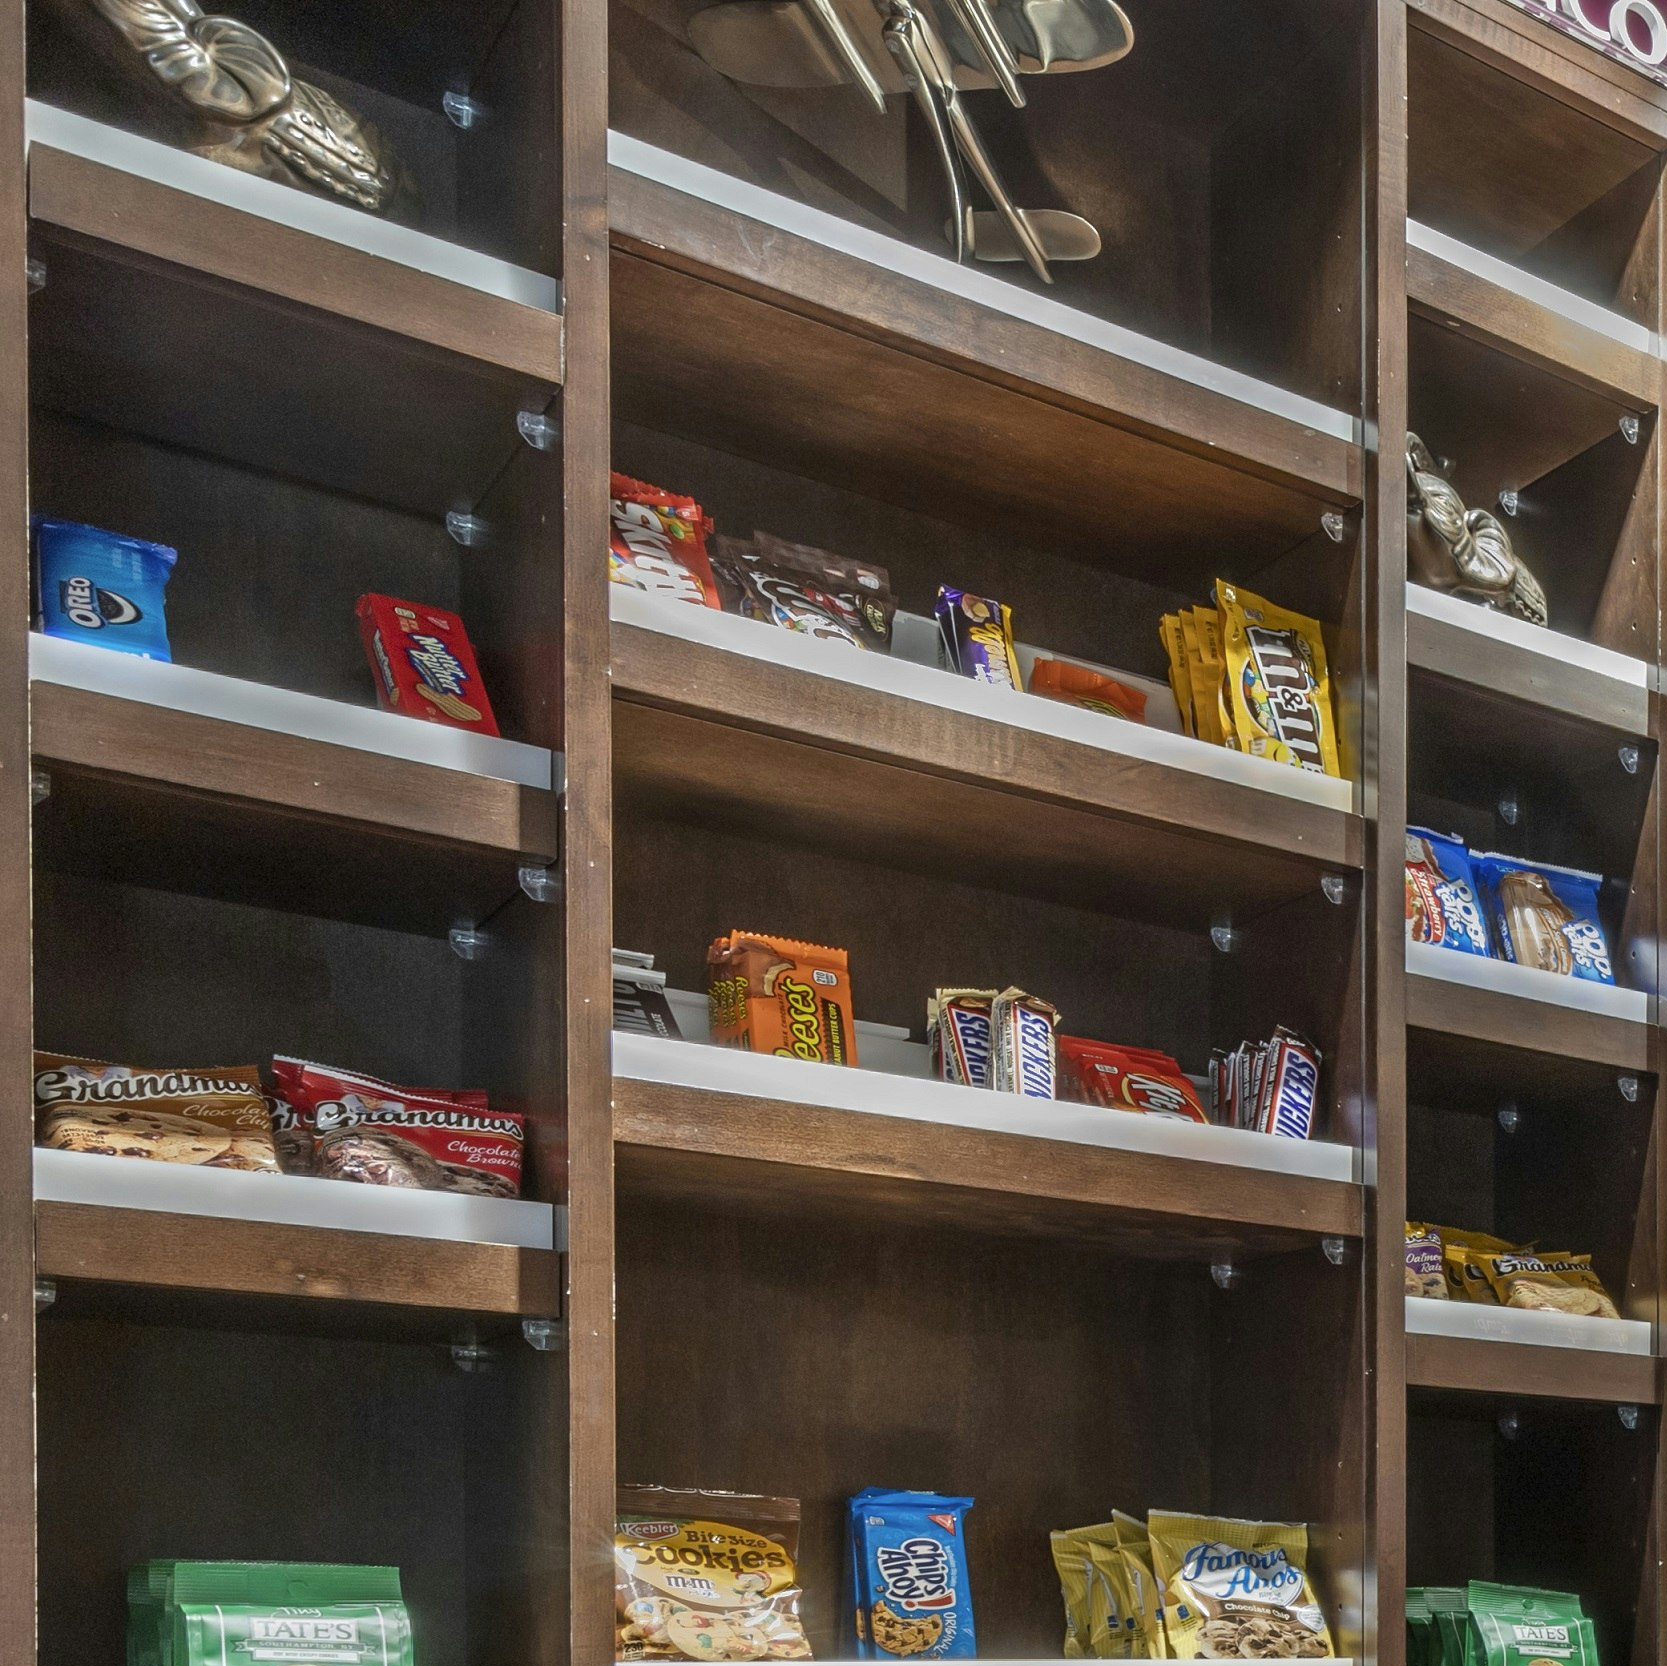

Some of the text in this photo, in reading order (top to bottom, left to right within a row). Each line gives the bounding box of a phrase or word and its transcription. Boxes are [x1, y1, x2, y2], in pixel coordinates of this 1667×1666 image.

[67, 576, 101, 627] OREO
[1417, 870, 1443, 937] Strawberry
[625, 1522, 677, 1536] Keebler
[729, 1534, 767, 1550] Size
[622, 1543, 786, 1573] Cookies
[903, 1538, 946, 1597] Chips
[1182, 1541, 1287, 1581] Famous
[1224, 1602, 1291, 1621] Chocolate Chip
[254, 1621, 354, 1641] TATE'S
[934, 1611, 958, 1654] ORIGINAL
